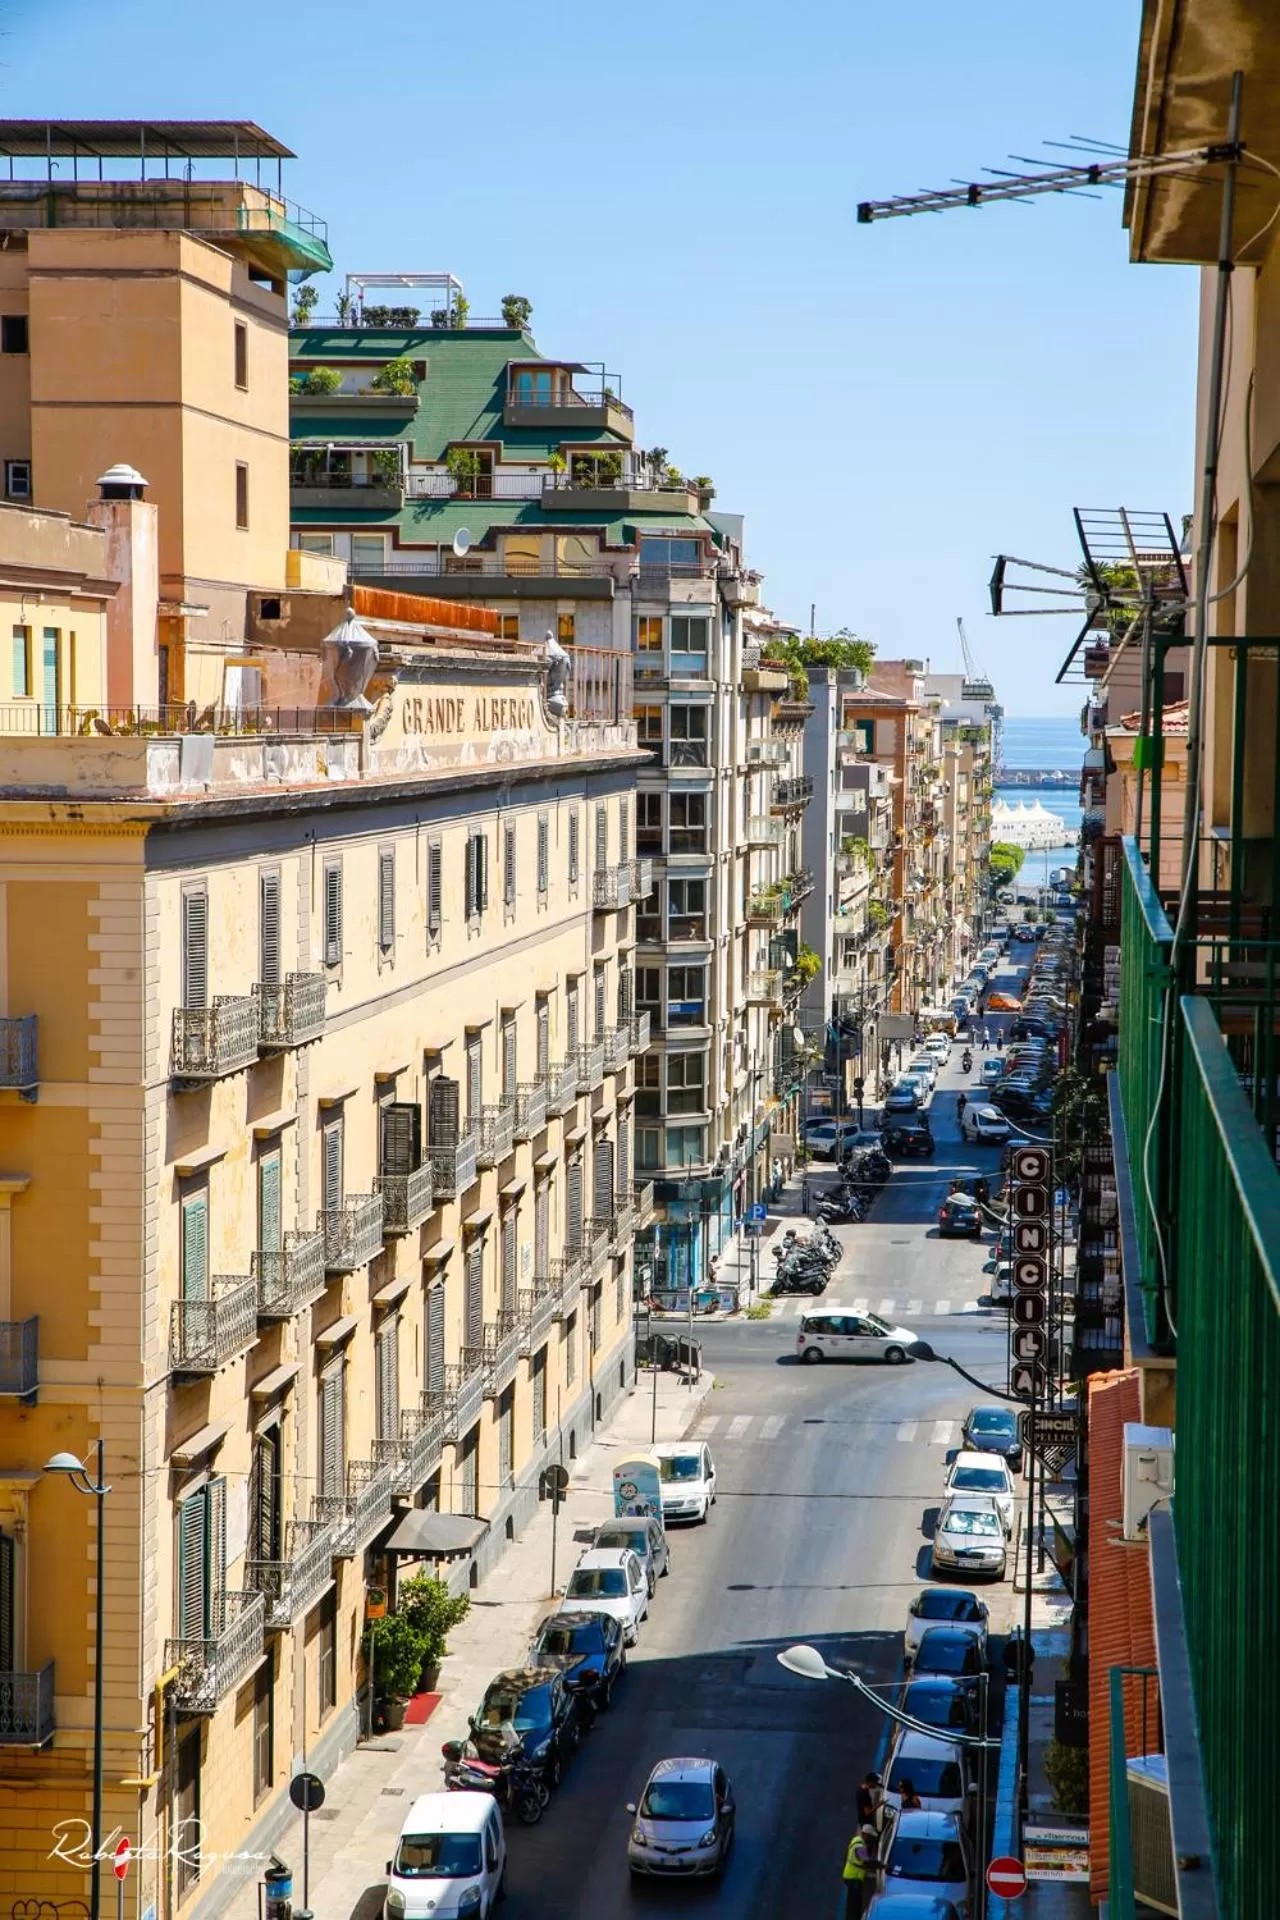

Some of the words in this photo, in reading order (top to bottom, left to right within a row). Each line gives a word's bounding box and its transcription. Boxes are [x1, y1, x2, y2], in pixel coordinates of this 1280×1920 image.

[402, 698, 466, 735] GRANDE
[473, 697, 536, 733] ALBERGO
[753, 1205, 765, 1219] P
